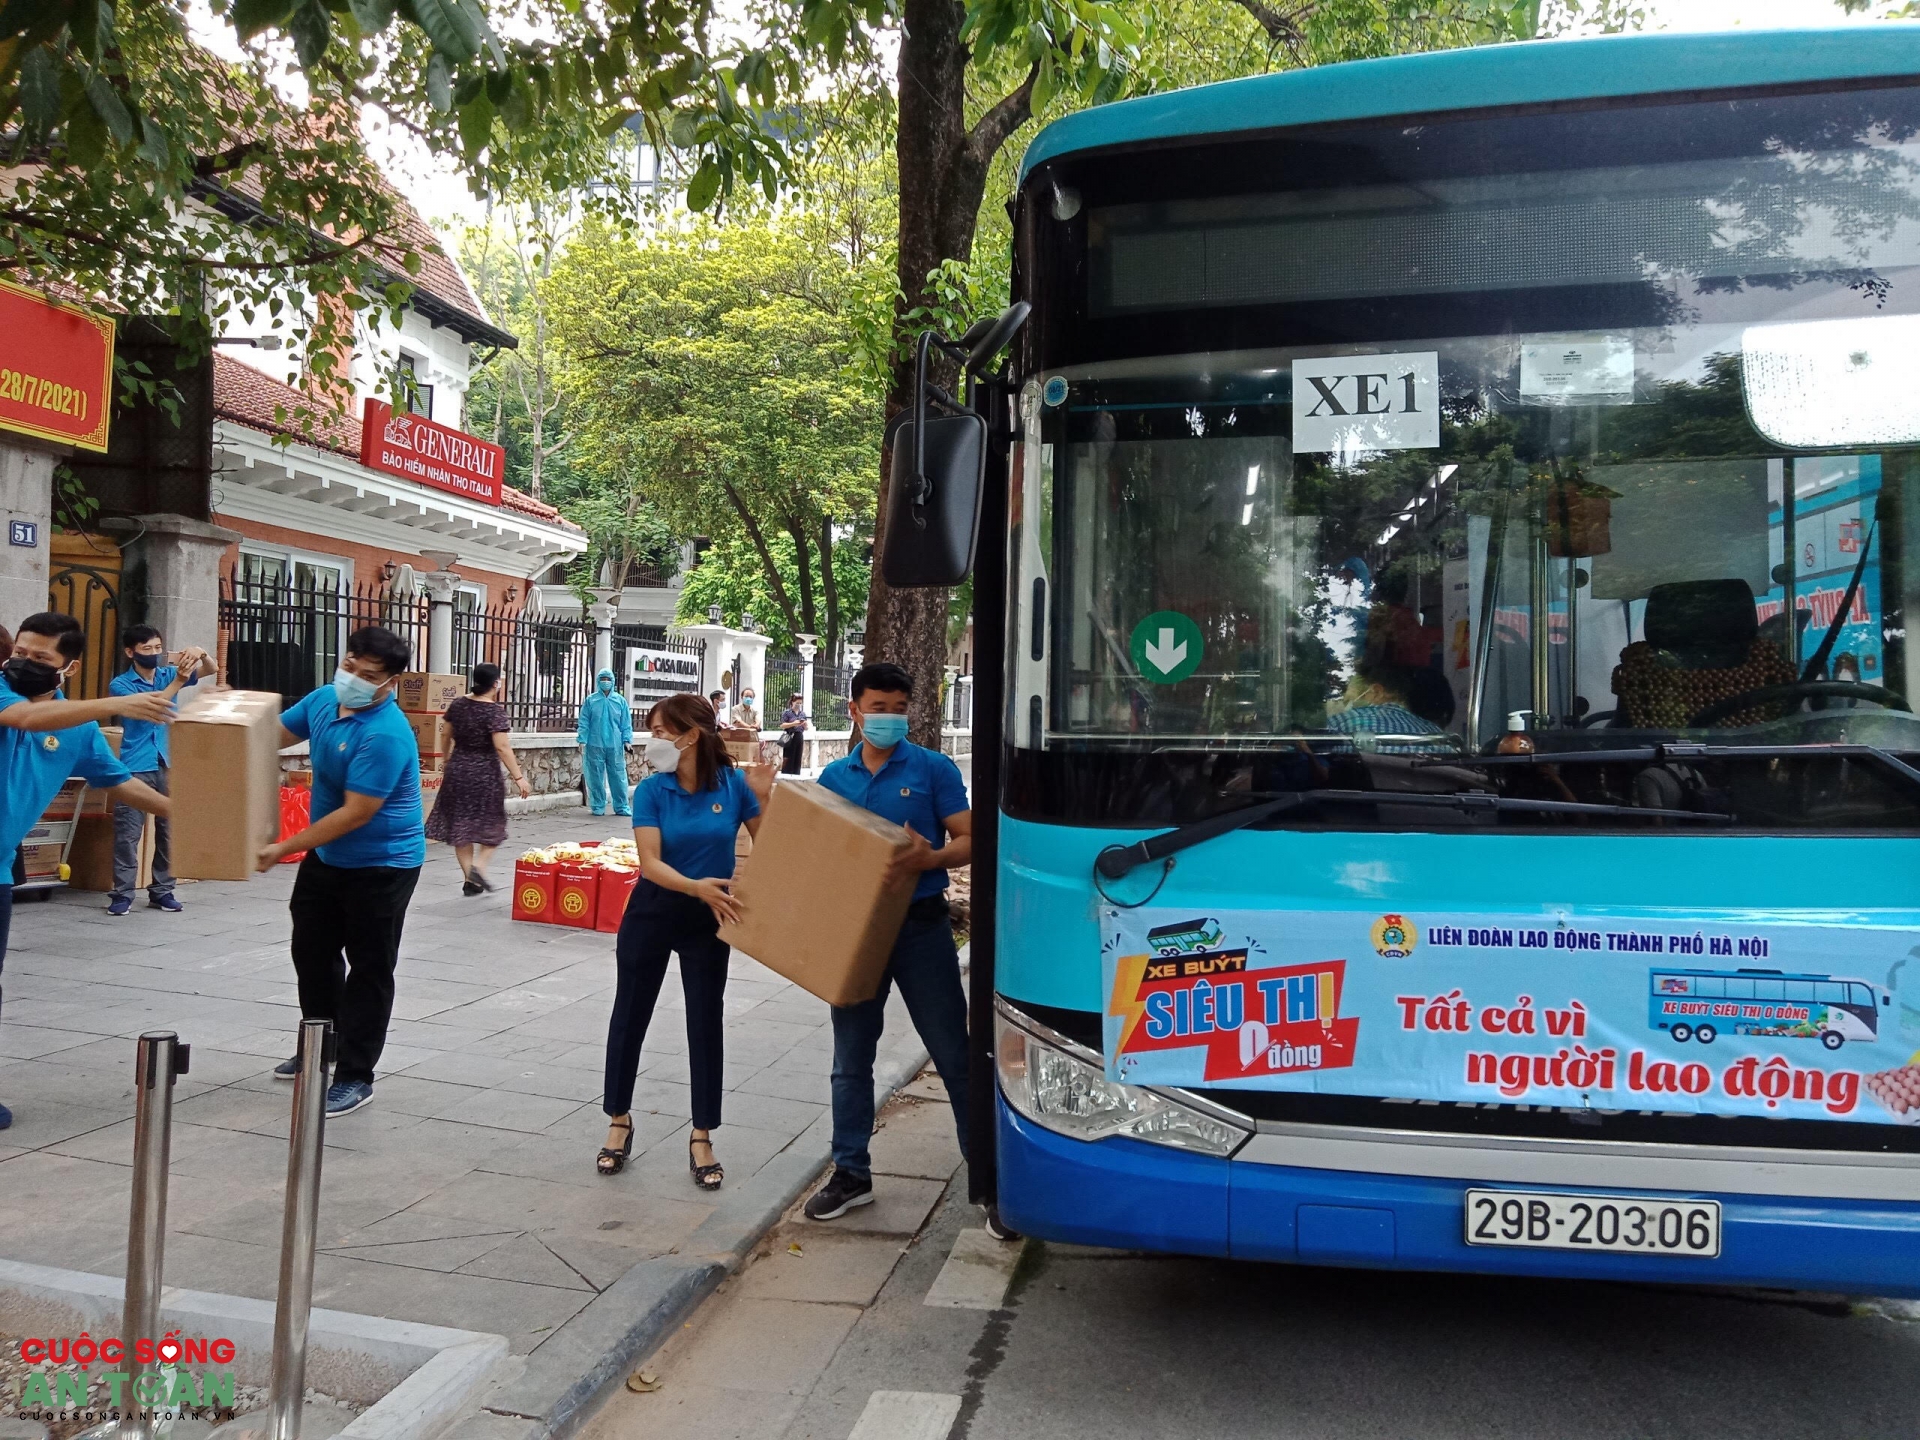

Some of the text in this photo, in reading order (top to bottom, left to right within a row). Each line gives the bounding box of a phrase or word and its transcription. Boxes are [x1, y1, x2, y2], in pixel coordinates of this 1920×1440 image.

[1304, 371, 1422, 418] XE1
[414, 424, 496, 479] GENERALI
[382, 450, 402, 469] BẢO
[404, 457, 426, 477] HIỂM
[452, 474, 468, 491] THỌ
[469, 480, 493, 498] ITALIA
[14, 524, 34, 543] 51
[403, 678, 423, 690] Staff
[654, 657, 698, 675] CASA ITALIA
[1428, 926, 1768, 960] LIÊN ĐOÀN LAO ĐỘNG THÀNH PHỐ HÀ NỘI
[1148, 954, 1246, 979] XE BUÝT
[1145, 979, 1245, 1039] SIÊU
[1397, 990, 1588, 1037] Tất cả vì
[1662, 1001, 1678, 1014] XE
[1267, 1039, 1322, 1069] đồng
[1467, 1046, 1615, 1096] người
[1628, 1052, 1711, 1095] lao
[1722, 1056, 1860, 1115] động
[1474, 1198, 1711, 1249] 29B-203.06
